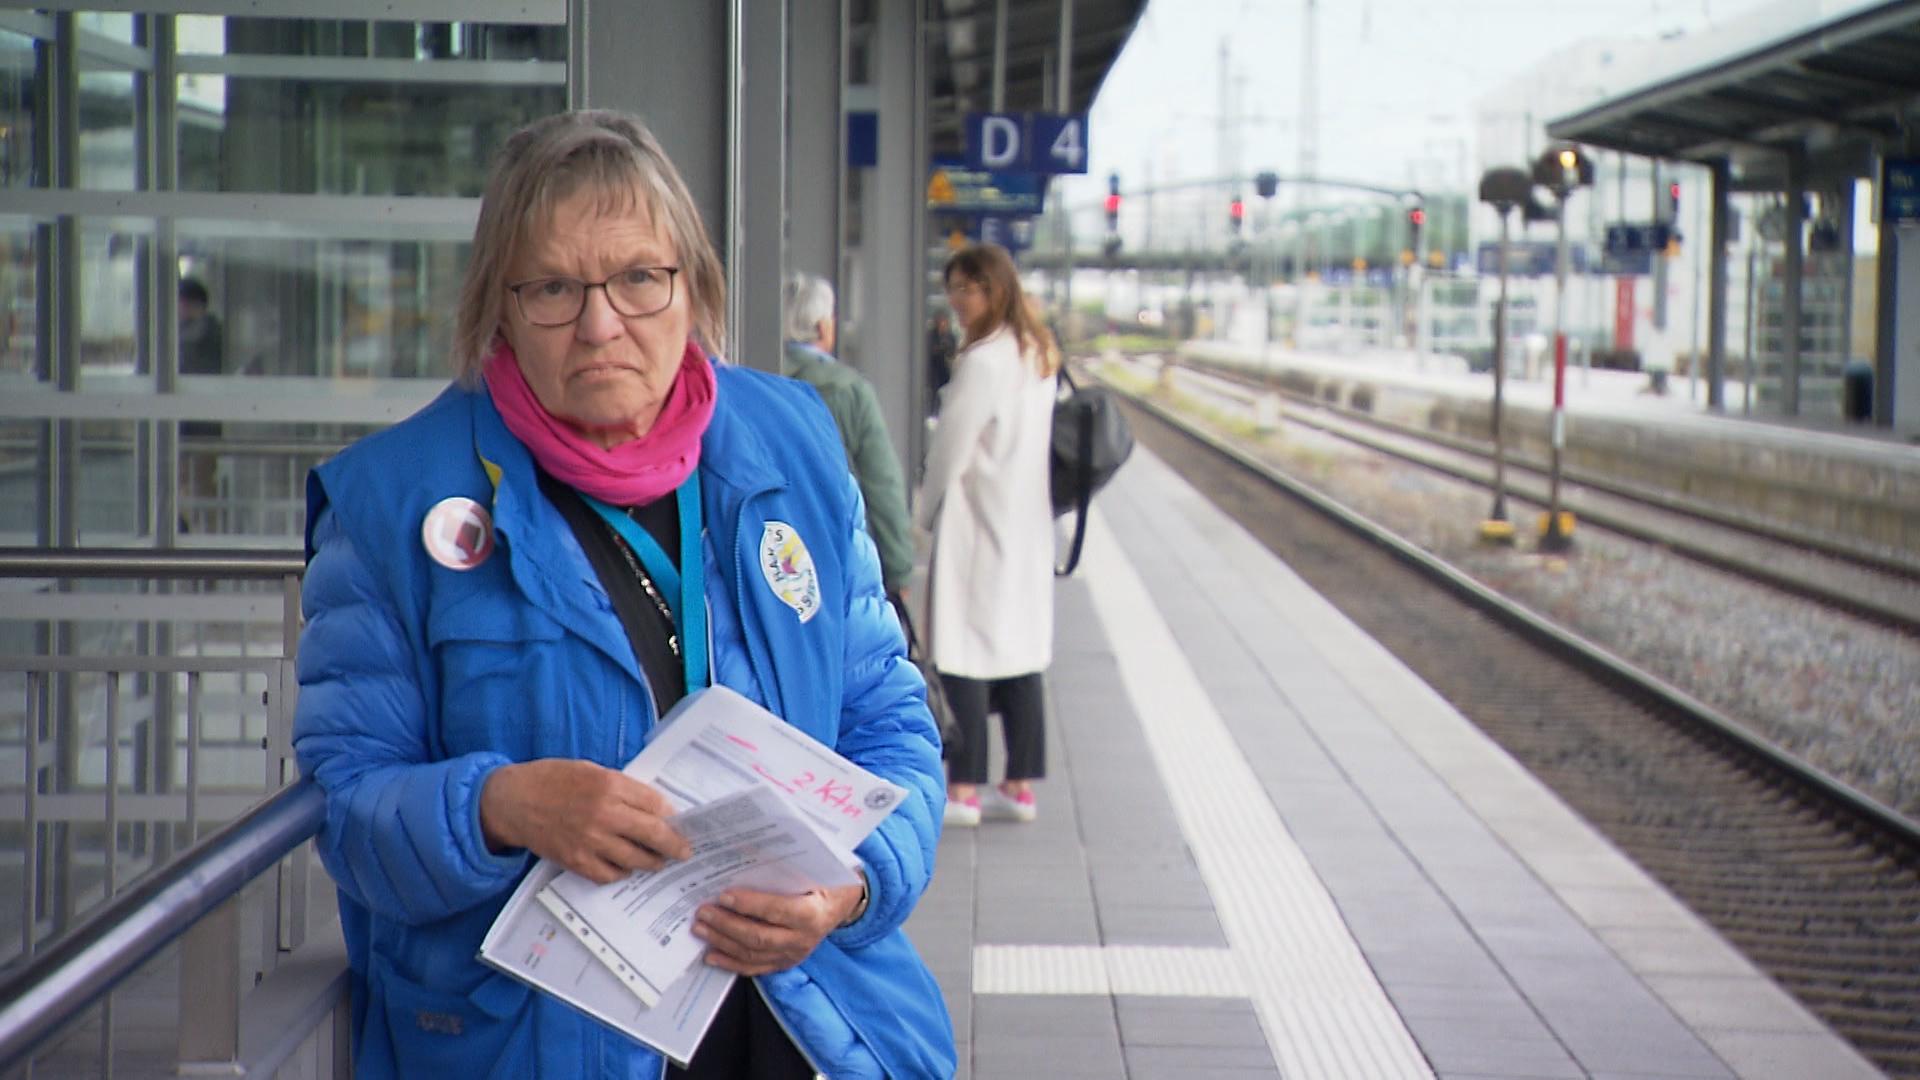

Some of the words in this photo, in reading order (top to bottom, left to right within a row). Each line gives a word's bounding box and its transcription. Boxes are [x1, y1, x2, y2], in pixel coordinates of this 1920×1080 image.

[981, 116, 1020, 167] D
[1049, 118, 1082, 167] 4
[791, 771, 816, 789] 2
